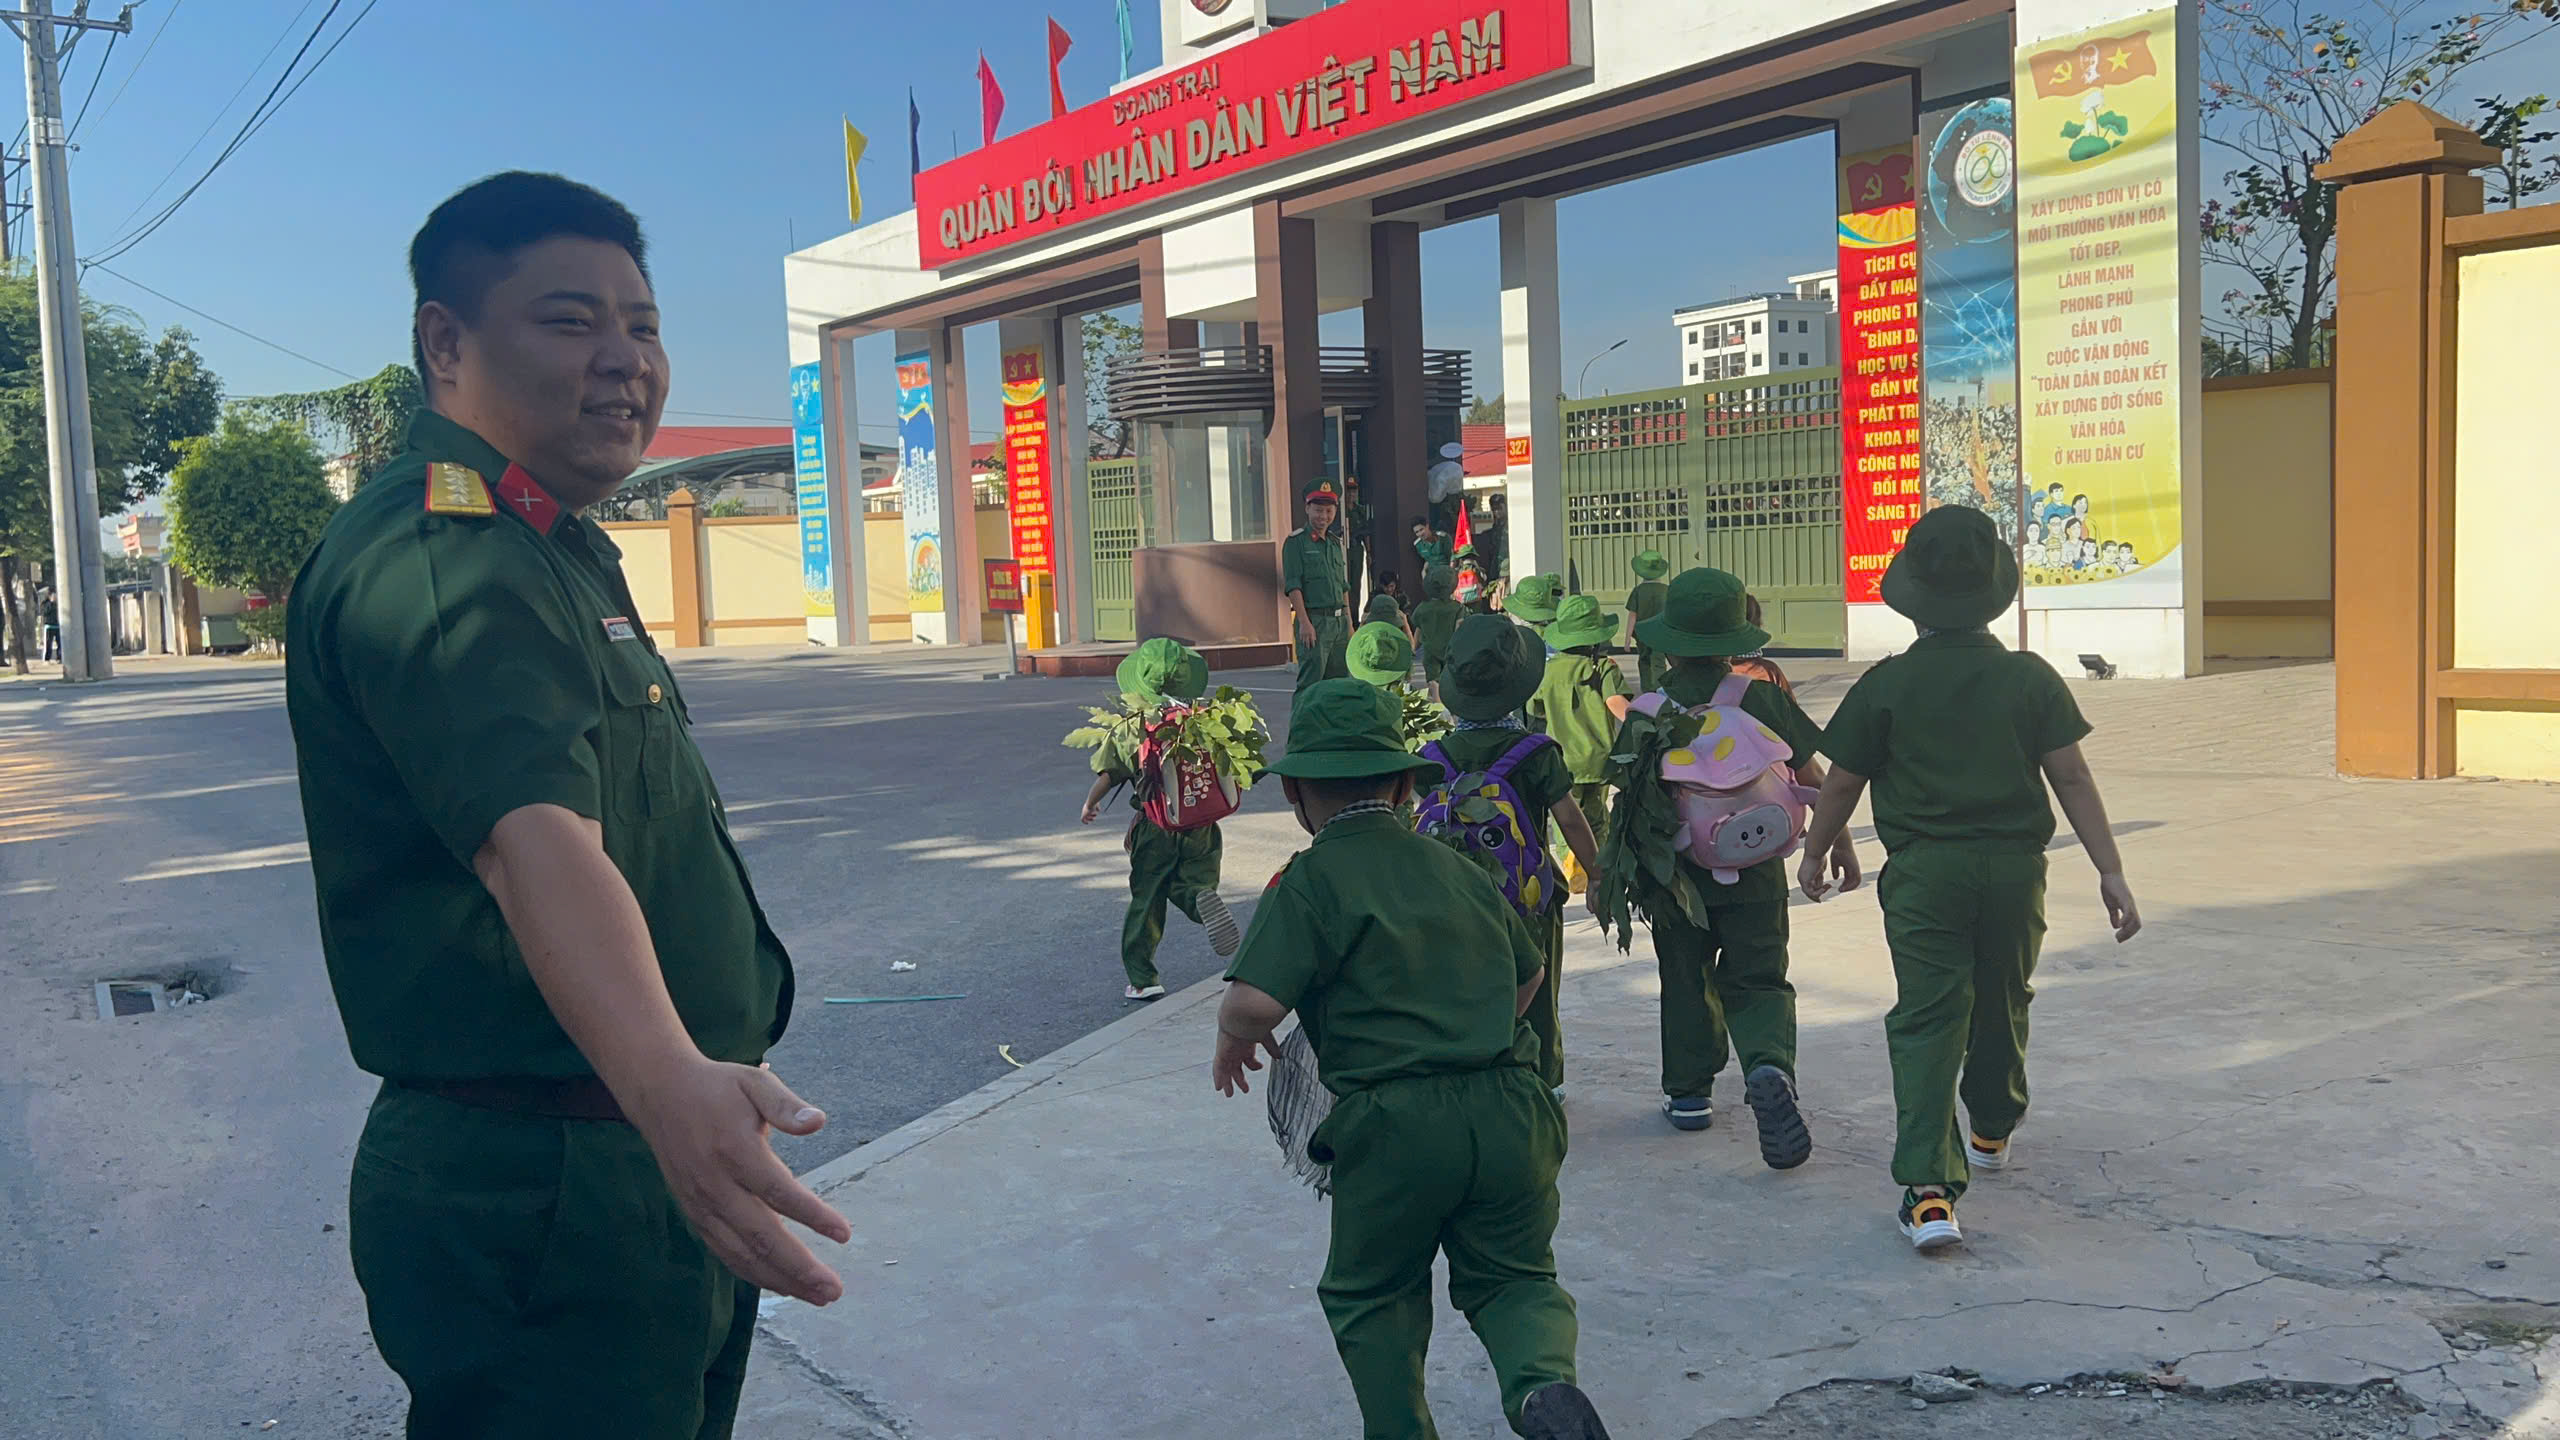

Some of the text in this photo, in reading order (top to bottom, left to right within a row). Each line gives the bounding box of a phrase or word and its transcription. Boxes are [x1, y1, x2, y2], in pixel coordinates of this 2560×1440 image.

[1114, 63, 1220, 125] DOANH TRẠI
[940, 10, 1505, 250] QUÂN ĐỘI NHÂN DÂN VIỆT NAM
[2031, 177, 2162, 217] XÂY DỰNG ĐƠN VỊ CÓ
[2028, 204, 2166, 243] MÔI TRƯỜNG VĂN HÓA
[2070, 240, 2122, 261] TỐT ĐẸP,
[1864, 255, 1896, 275] TÍCH
[2058, 264, 2134, 289] LÀNH MẠNH
[2060, 287, 2133, 314] PHONG PHÚ
[1853, 304, 1901, 326] PHONG
[2071, 315, 2122, 338] GẮN VỚI
[2047, 339, 2149, 367] CUỘC VẬN ĐỘNG
[1857, 357, 1886, 377] HỌC
[1889, 354, 1908, 373] VỤ
[2073, 370, 2100, 388] DÂN
[2103, 365, 2139, 385] ĐOÀN
[2143, 359, 2168, 381] KẾT
[1870, 375, 1900, 398] GẮN
[2035, 387, 2163, 416] XÂY DỰNG ĐỜI SỐNG
[1859, 404, 1895, 424] PHÁT
[1865, 430, 1902, 448] KHOA
[2070, 418, 2126, 439] VĂN HÓA
[1509, 439, 1527, 456] 327
[2054, 442, 2145, 465] Ở KHU DÂN CƯ
[1858, 454, 1896, 472] CÔNG
[1873, 475, 1897, 496] ĐỔI
[1867, 501, 1905, 521] SÁNG
